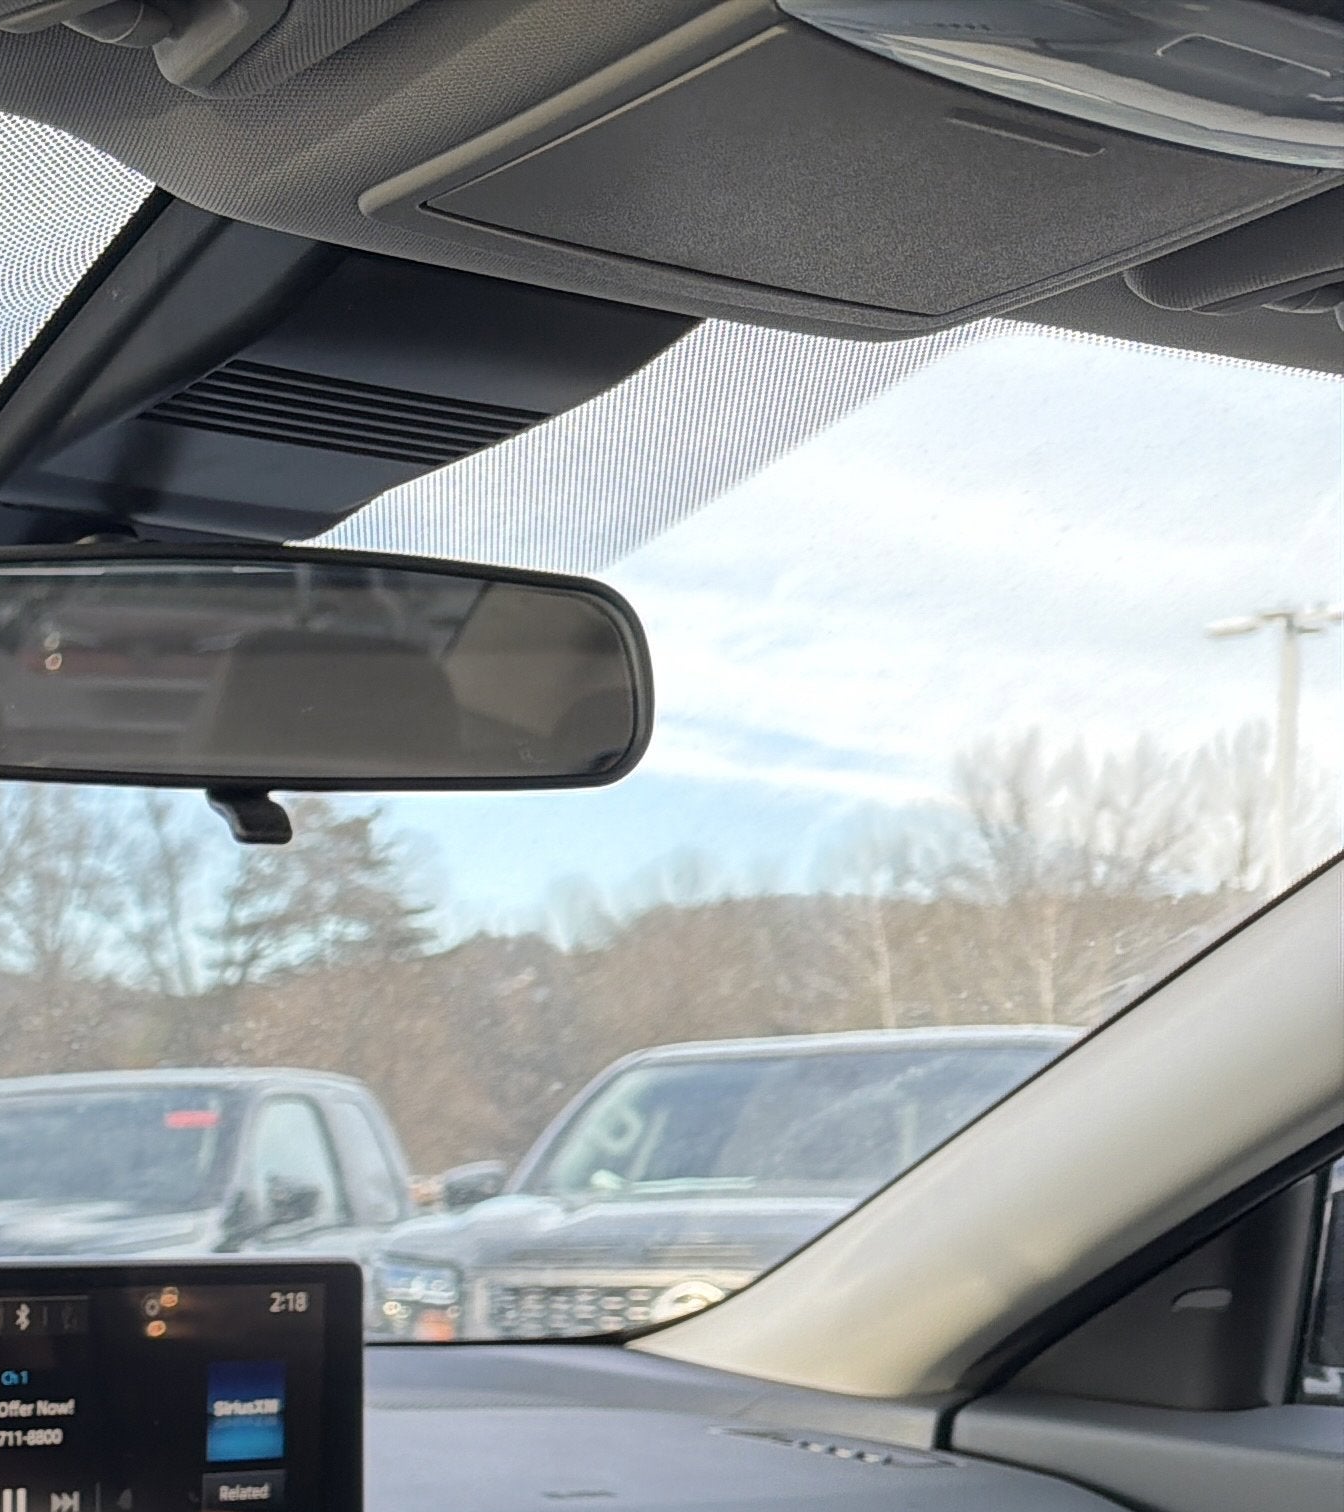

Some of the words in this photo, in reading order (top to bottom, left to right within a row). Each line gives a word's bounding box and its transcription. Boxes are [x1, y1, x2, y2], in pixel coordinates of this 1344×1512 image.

[269, 1291, 309, 1313] 2:18
[36, 1398, 75, 1416] Now!
[219, 1482, 271, 1502] Related
